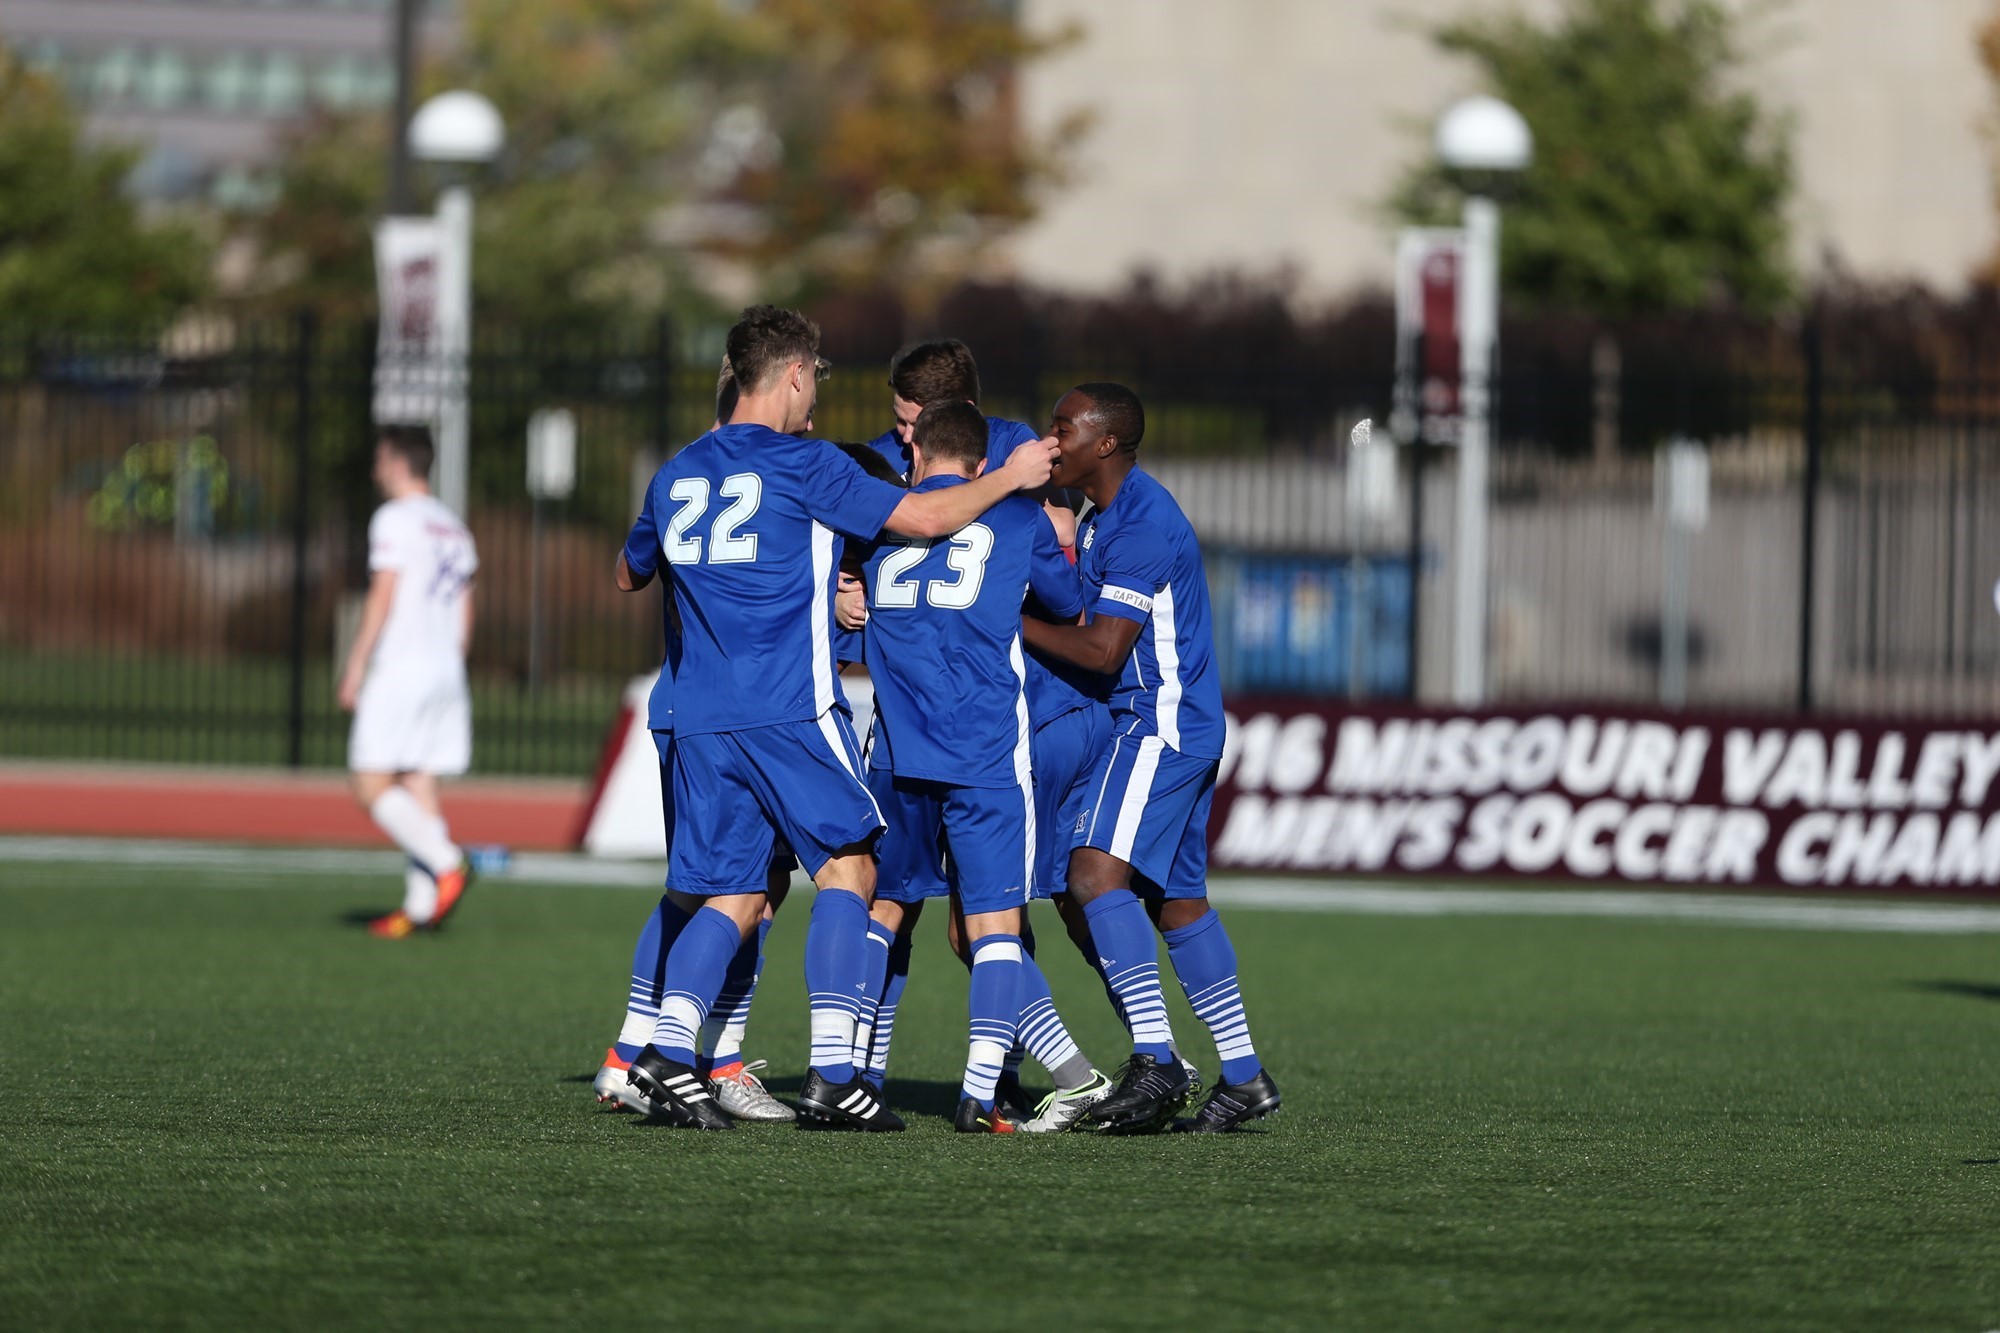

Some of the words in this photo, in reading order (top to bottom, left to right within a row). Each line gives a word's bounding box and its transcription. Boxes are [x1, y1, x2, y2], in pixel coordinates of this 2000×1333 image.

[663, 472, 763, 565] 22
[875, 522, 995, 610] 23
[1113, 590, 1153, 611] CAPTAIN
[1325, 715, 1711, 800] MISSOURI
[1723, 728, 2000, 809] VALLEY
[1213, 794, 1464, 871] MEN'S
[1455, 792, 1770, 882] SOCCER
